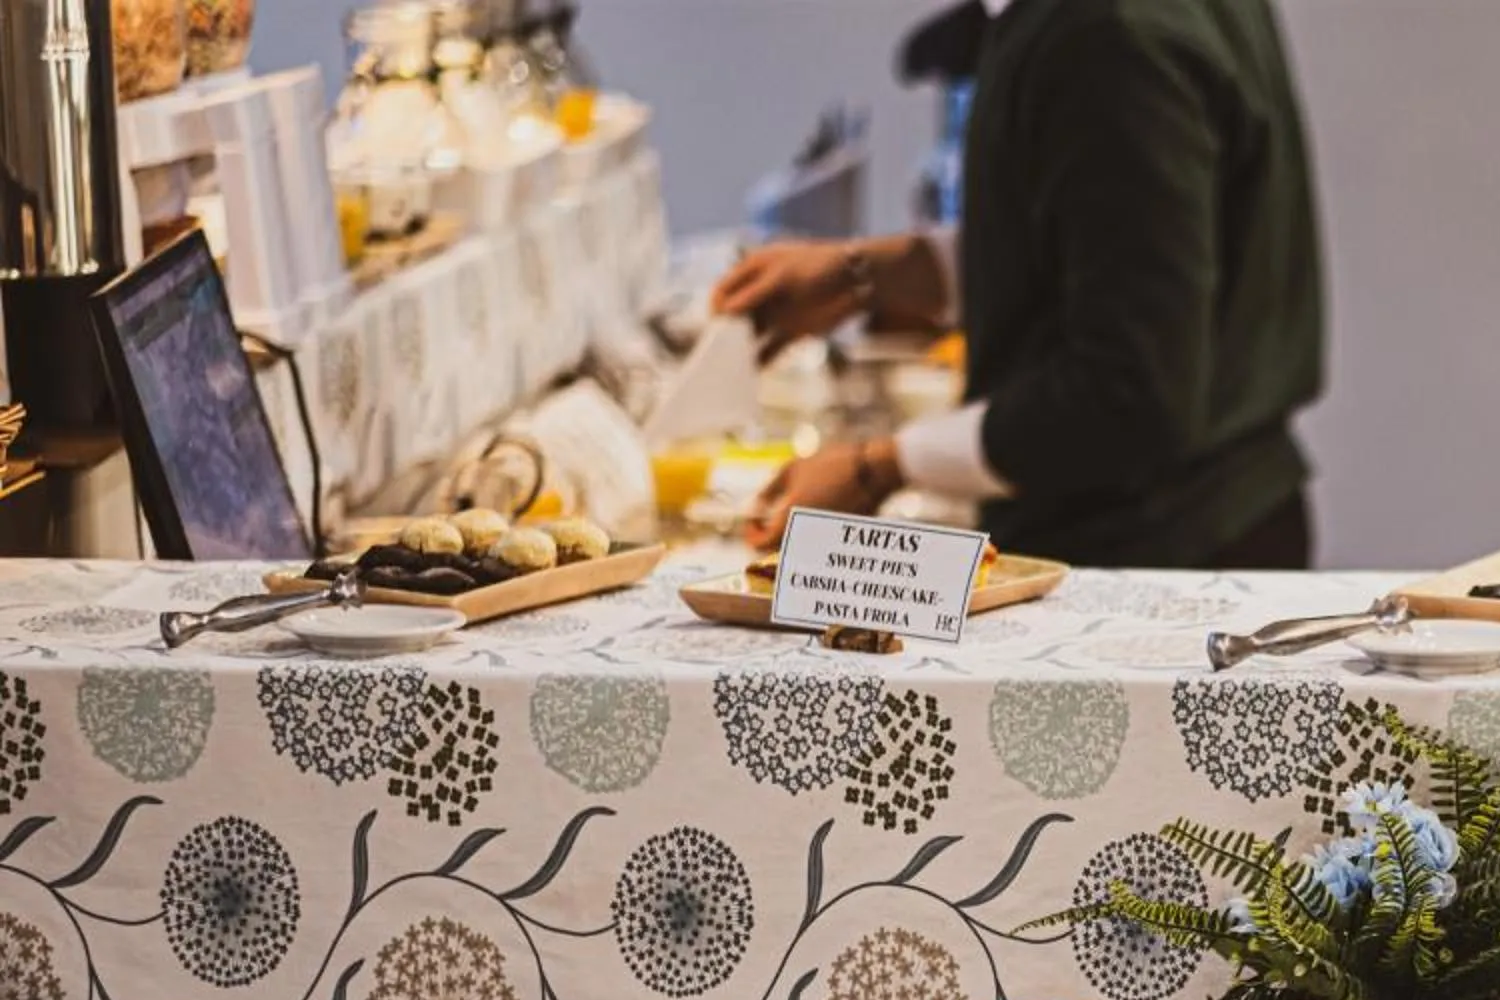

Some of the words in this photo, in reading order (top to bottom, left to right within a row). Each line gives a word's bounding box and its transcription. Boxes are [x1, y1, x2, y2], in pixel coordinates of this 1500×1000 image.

[842, 525, 921, 553] TARTAS
[827, 552, 876, 573] SWEET
[813, 601, 858, 621] PASTA
[863, 607, 910, 627] FROLA
